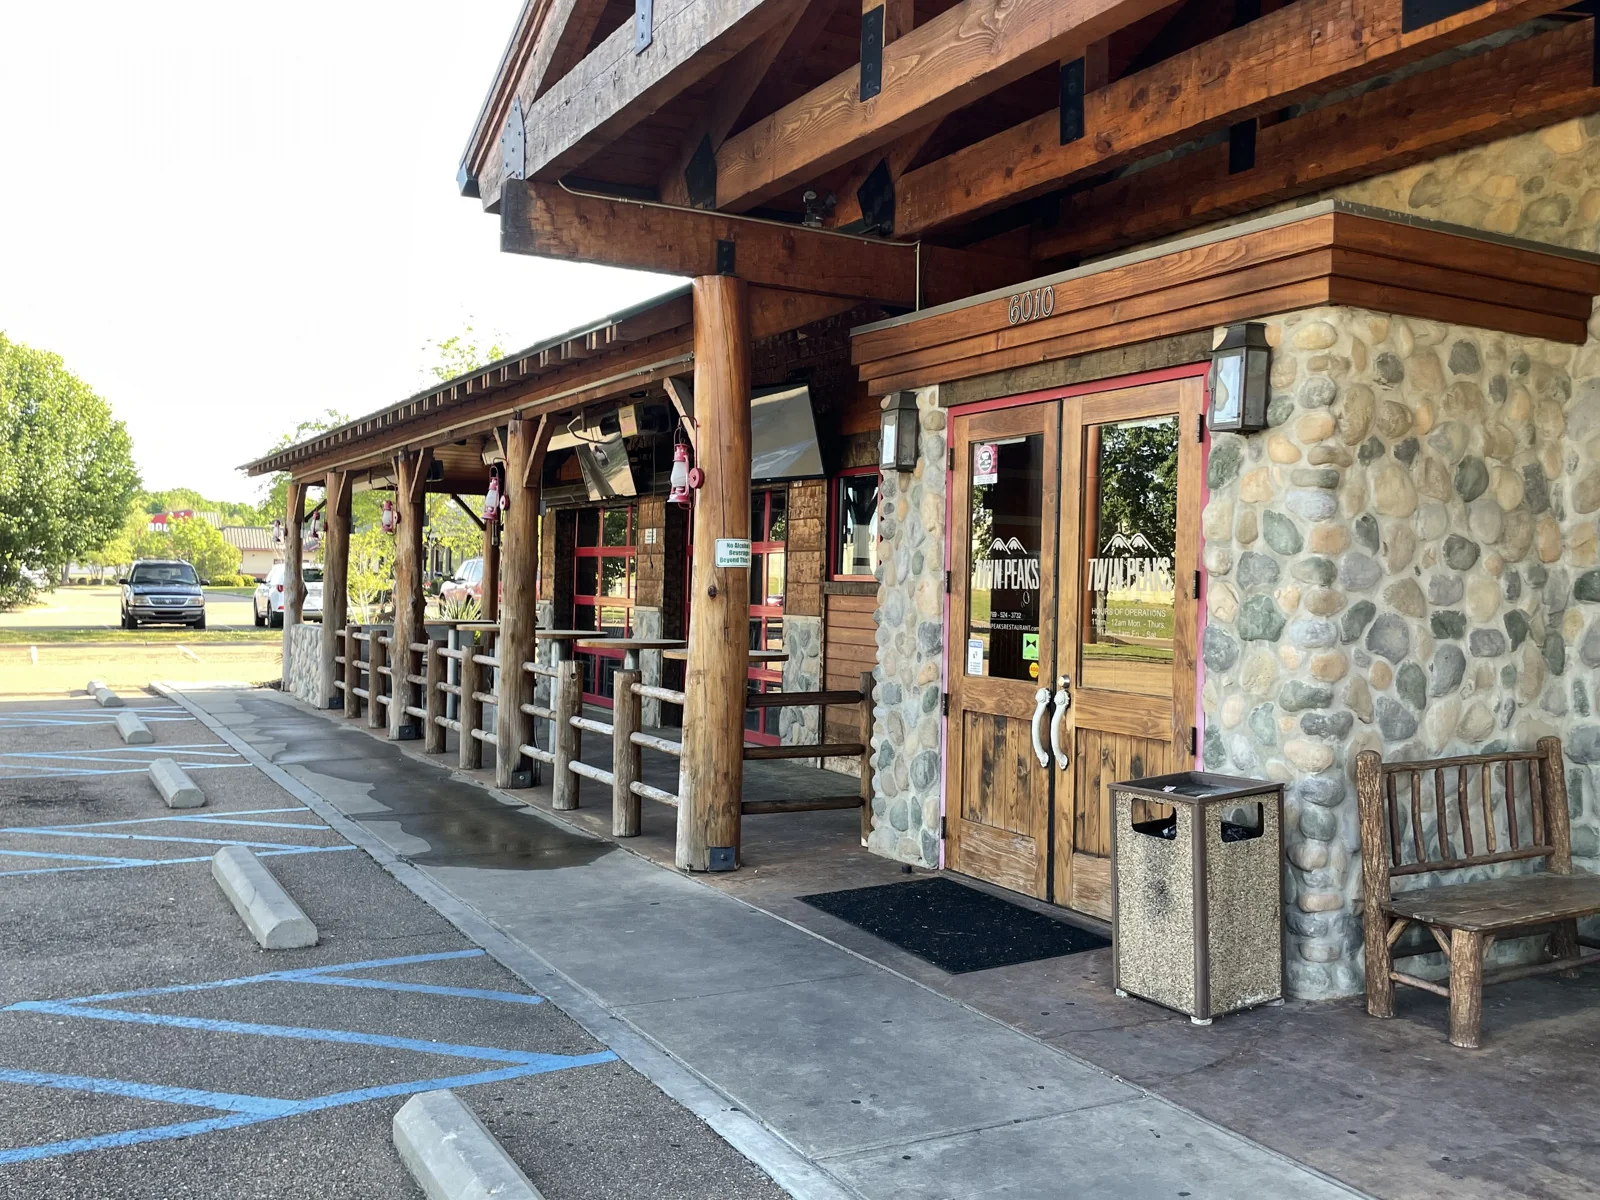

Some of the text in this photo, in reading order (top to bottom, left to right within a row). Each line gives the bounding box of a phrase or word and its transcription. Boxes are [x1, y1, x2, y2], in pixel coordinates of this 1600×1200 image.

[1009, 286, 1055, 324] 6010
[975, 559, 1040, 590] TWIN PEAKS
[1088, 557, 1174, 592] TWIN PEAKS
[1091, 607, 1167, 618] HOURS OF OPERATIONS
